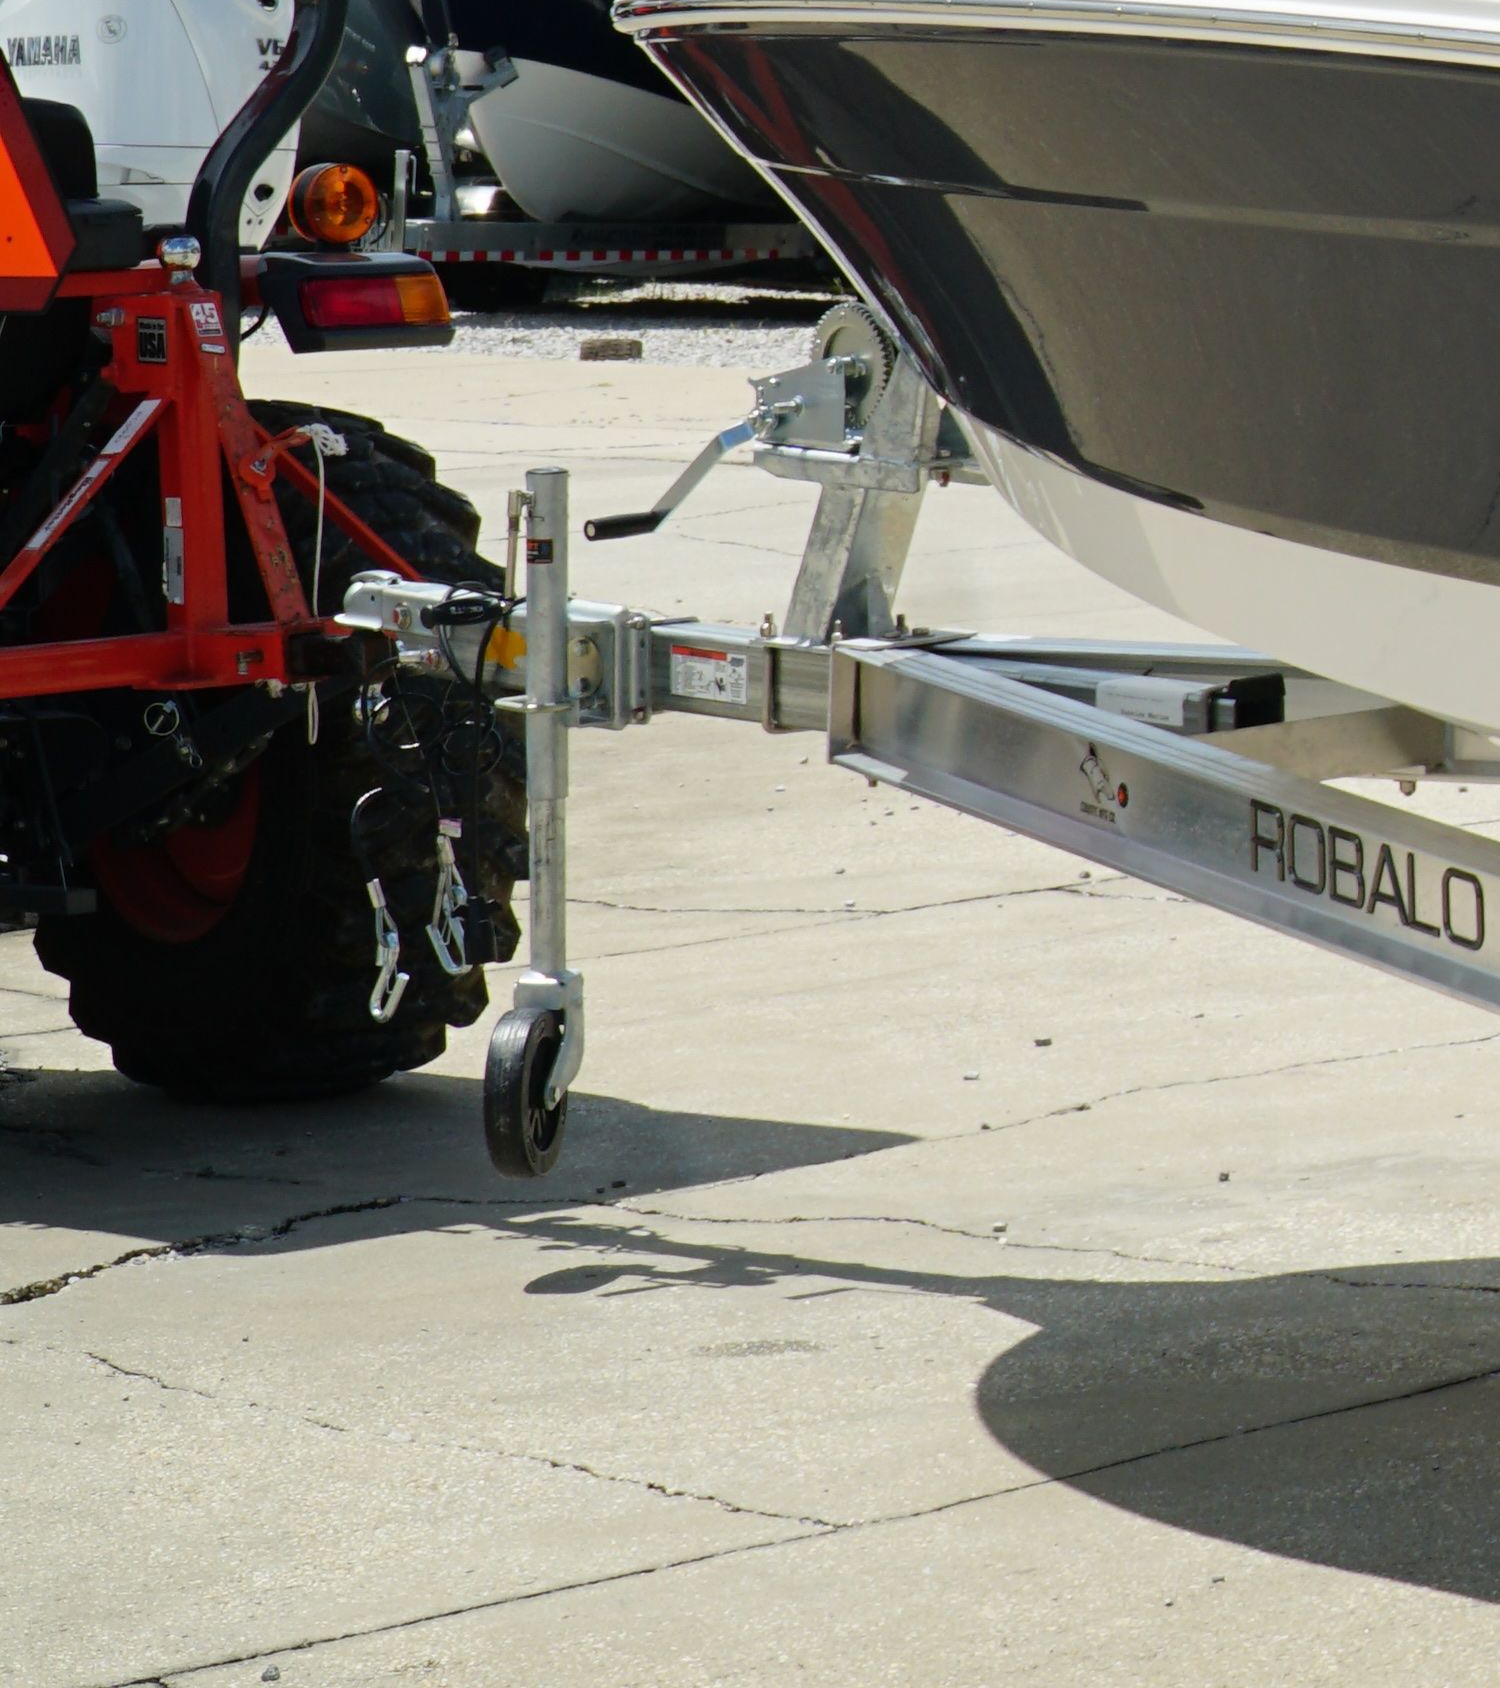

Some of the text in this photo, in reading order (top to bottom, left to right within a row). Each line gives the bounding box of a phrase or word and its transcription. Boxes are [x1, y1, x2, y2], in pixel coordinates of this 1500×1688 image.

[7, 35, 81, 67] YAMAHA
[192, 303, 219, 325] 45
[139, 332, 166, 359] USA
[1248, 798, 1486, 951] ROBALO
